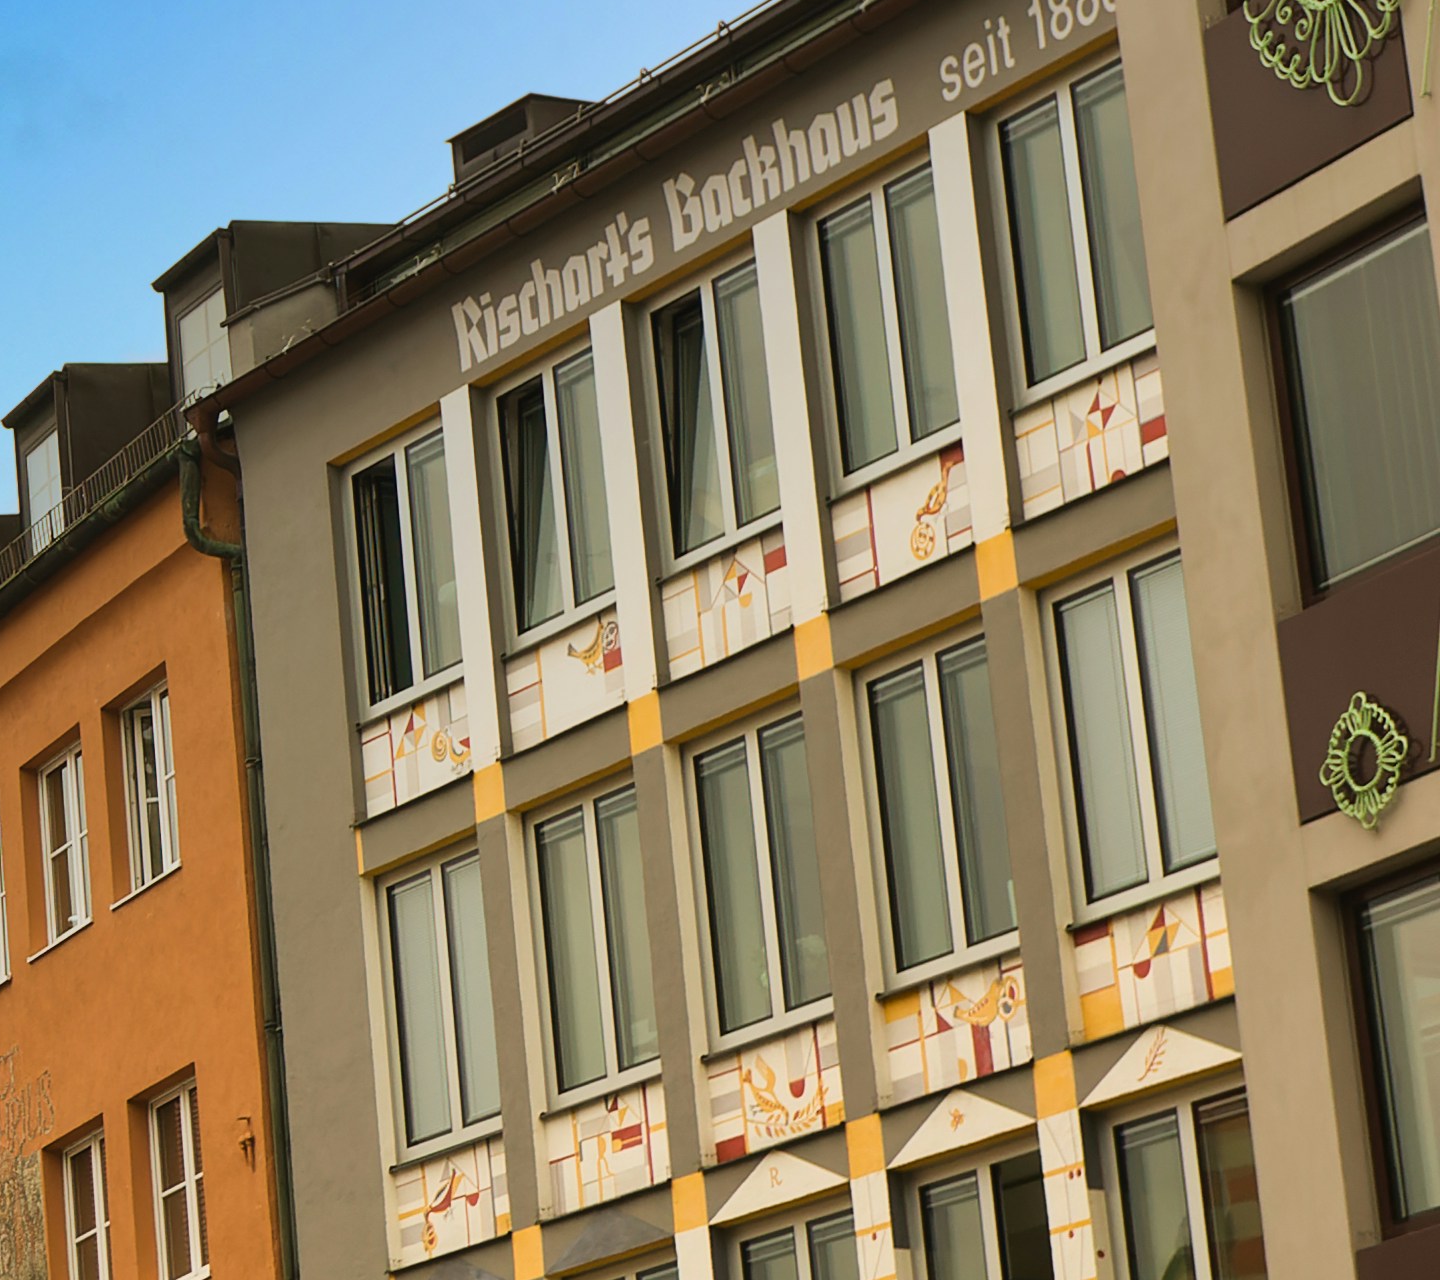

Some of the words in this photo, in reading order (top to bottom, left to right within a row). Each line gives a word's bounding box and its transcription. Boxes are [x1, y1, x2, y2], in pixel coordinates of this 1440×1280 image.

[451, 211, 654, 373] Rischart's
[663, 79, 898, 252] Backhaus
[940, 16, 1015, 101] seit
